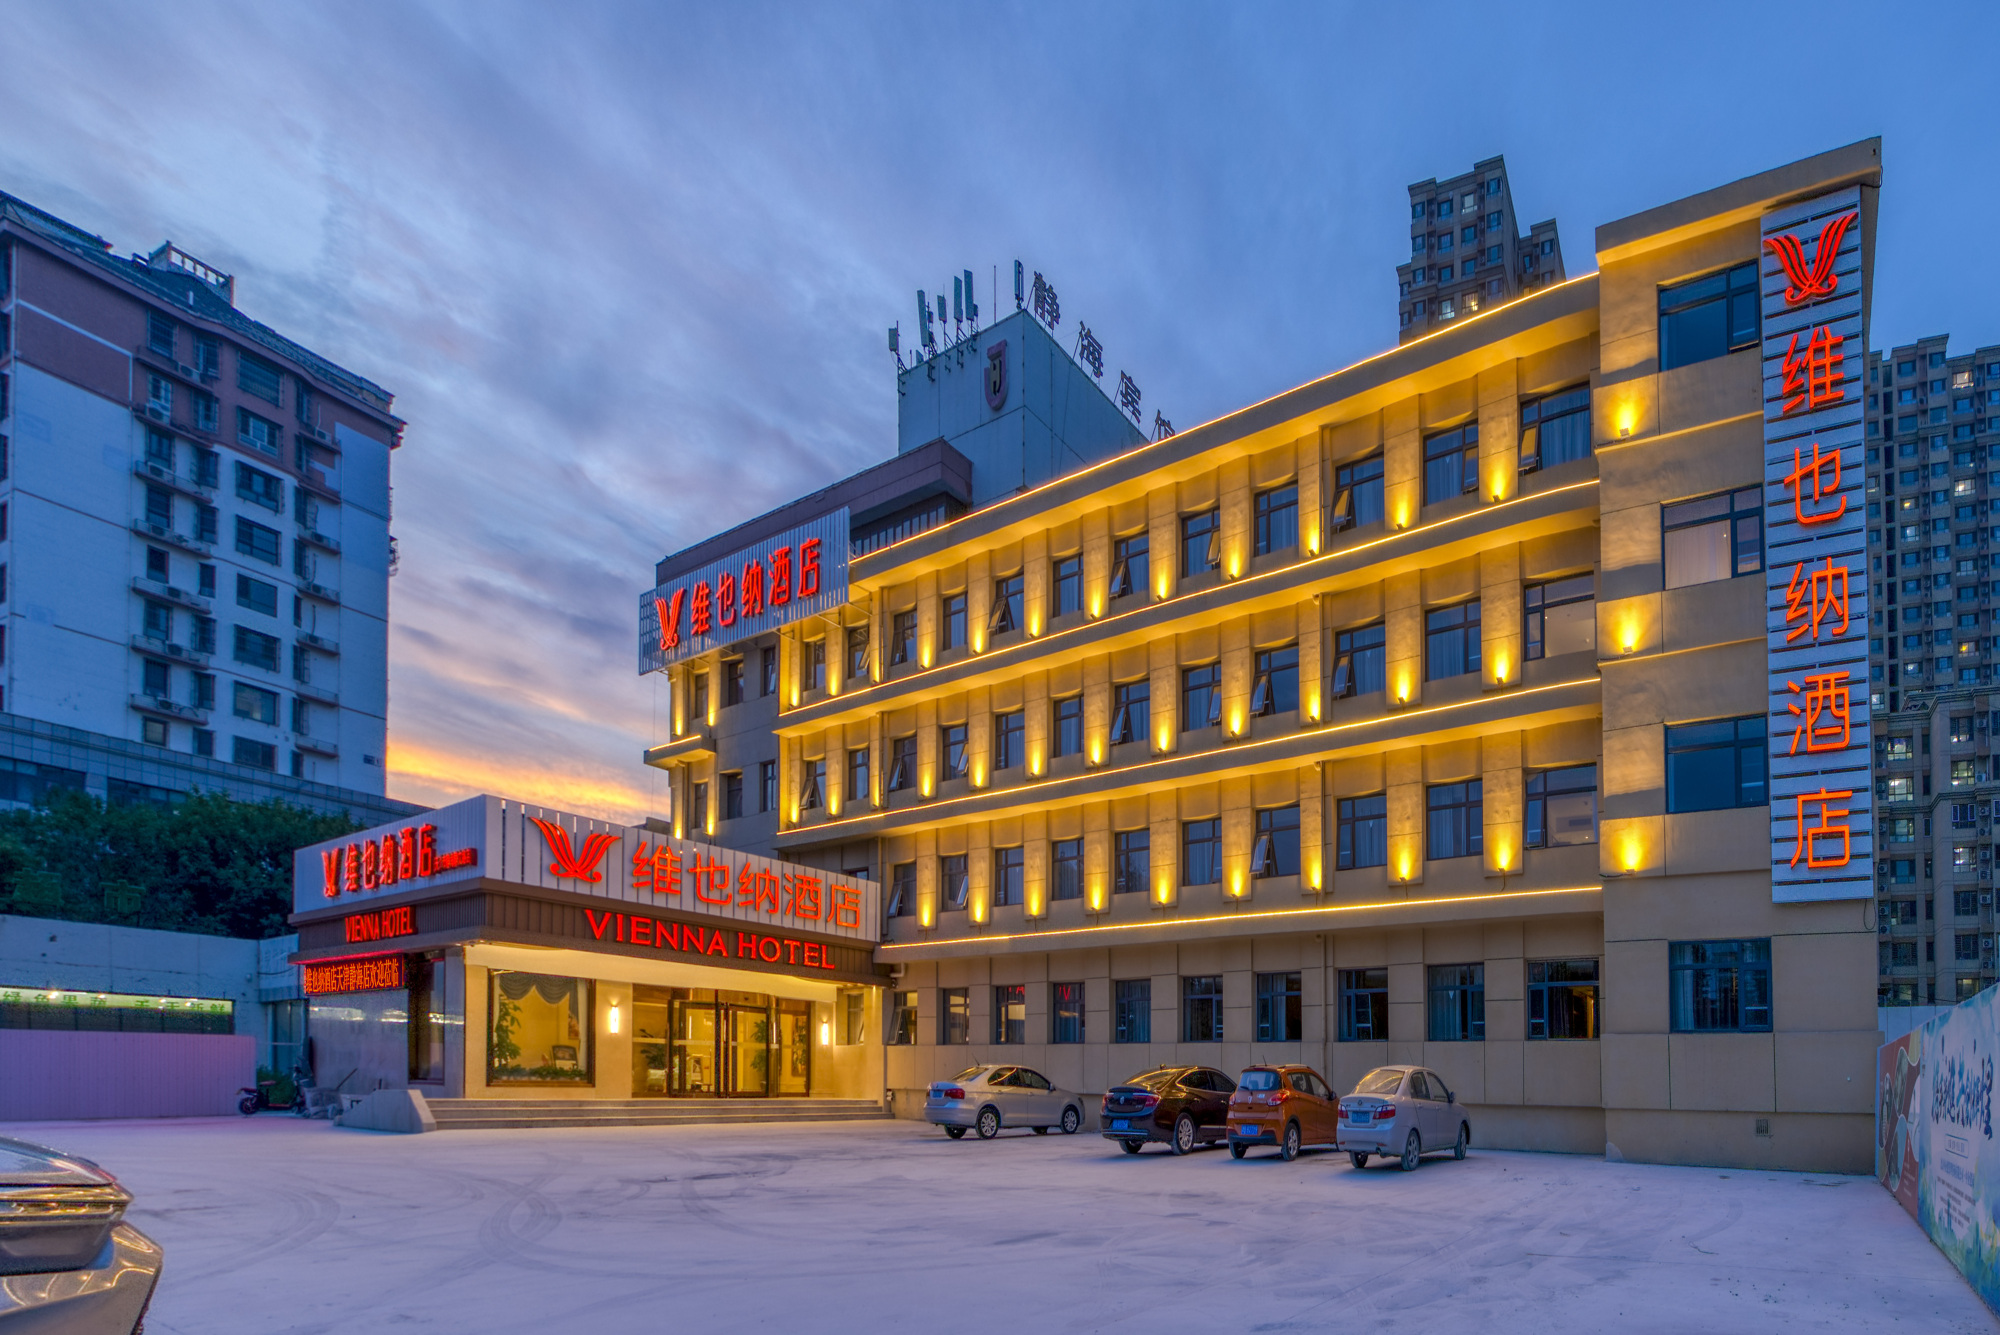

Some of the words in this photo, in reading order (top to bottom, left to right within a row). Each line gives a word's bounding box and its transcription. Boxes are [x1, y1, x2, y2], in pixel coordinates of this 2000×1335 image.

[691, 537, 821, 635] 维也纳酒店
[1781, 325, 1854, 869] 维也纳酒店
[344, 824, 433, 892] 维也纳酒店
[632, 841, 862, 929] 维也纳酒店
[345, 914, 380, 942] VIENNA
[381, 906, 413, 938] HOTEL
[584, 908, 729, 957] VIENNA
[737, 932, 836, 969] HOTEL
